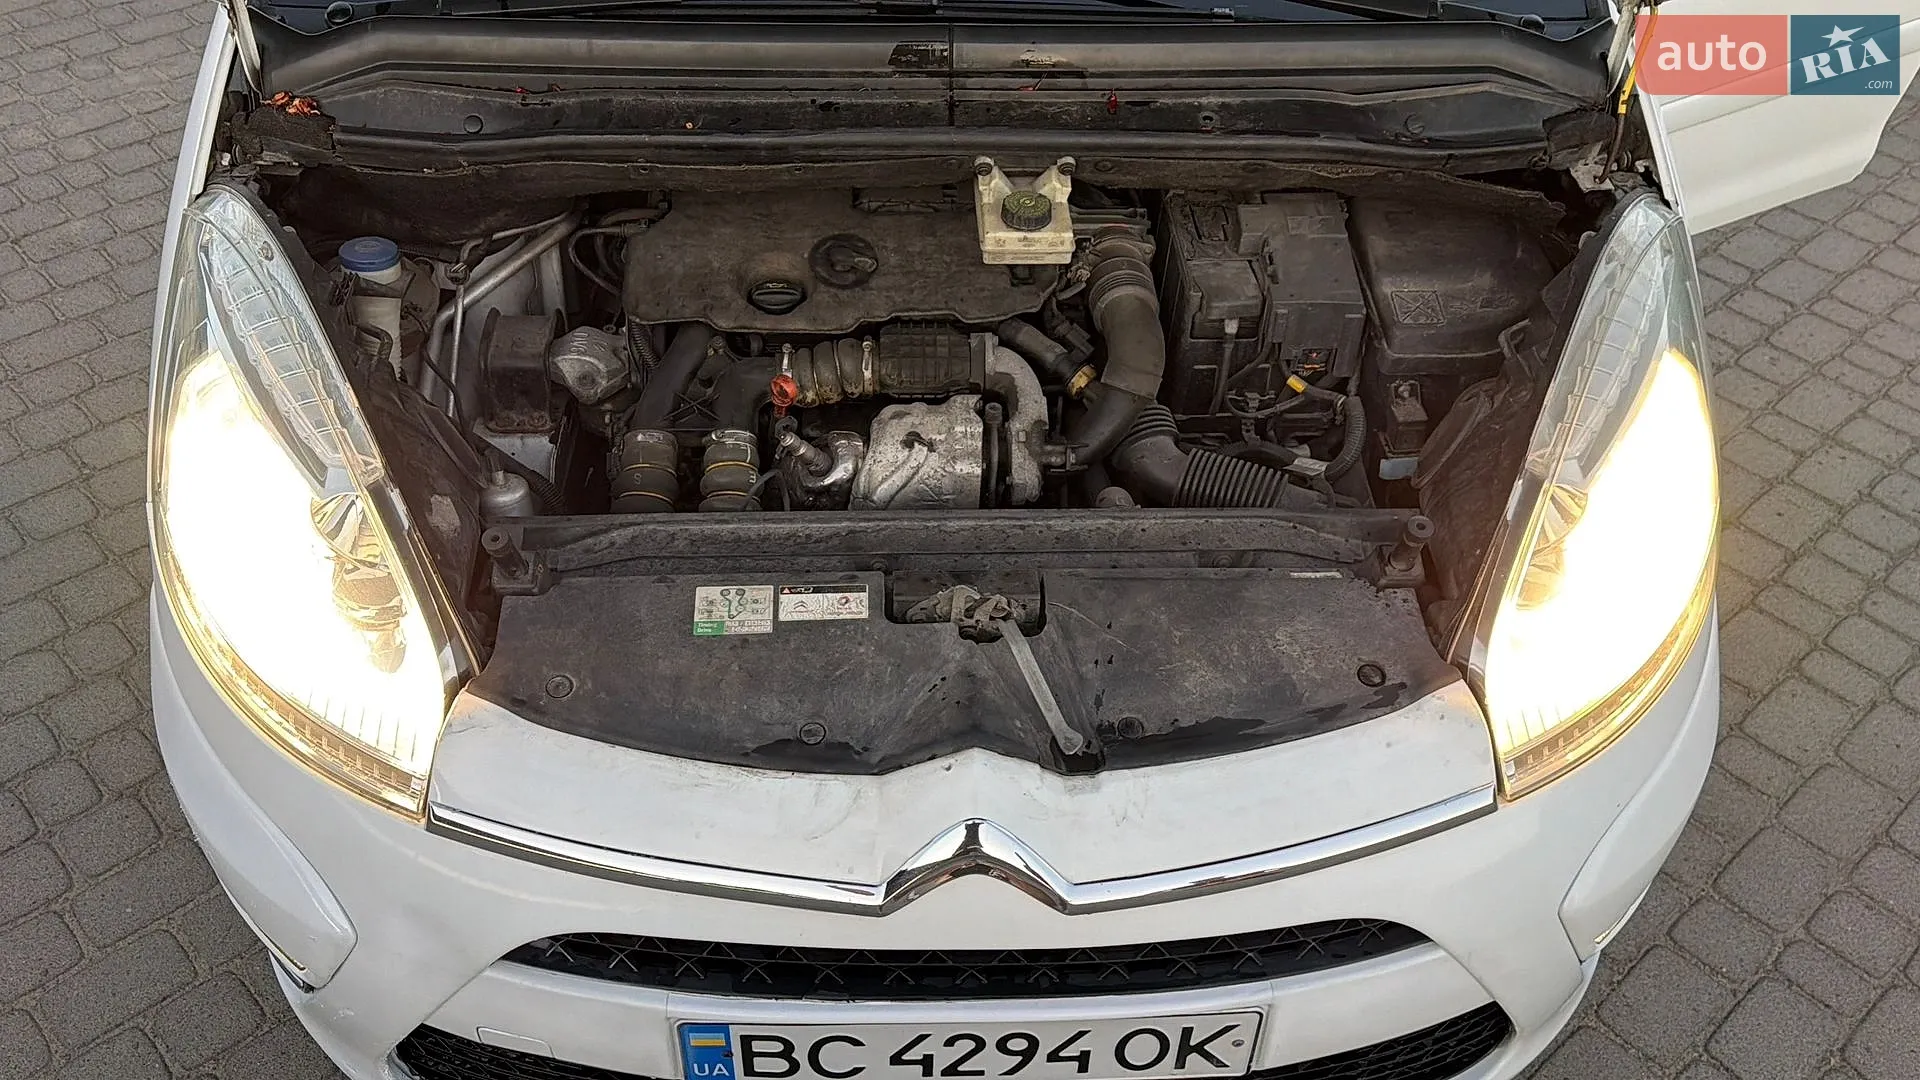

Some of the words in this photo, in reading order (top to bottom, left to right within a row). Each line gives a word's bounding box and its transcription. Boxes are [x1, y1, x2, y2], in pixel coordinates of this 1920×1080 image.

[740, 1035, 867, 1079] BC
[889, 1030, 1092, 1077] 4294
[1114, 1024, 1241, 1071] OK
[693, 1063, 730, 1077] UA
